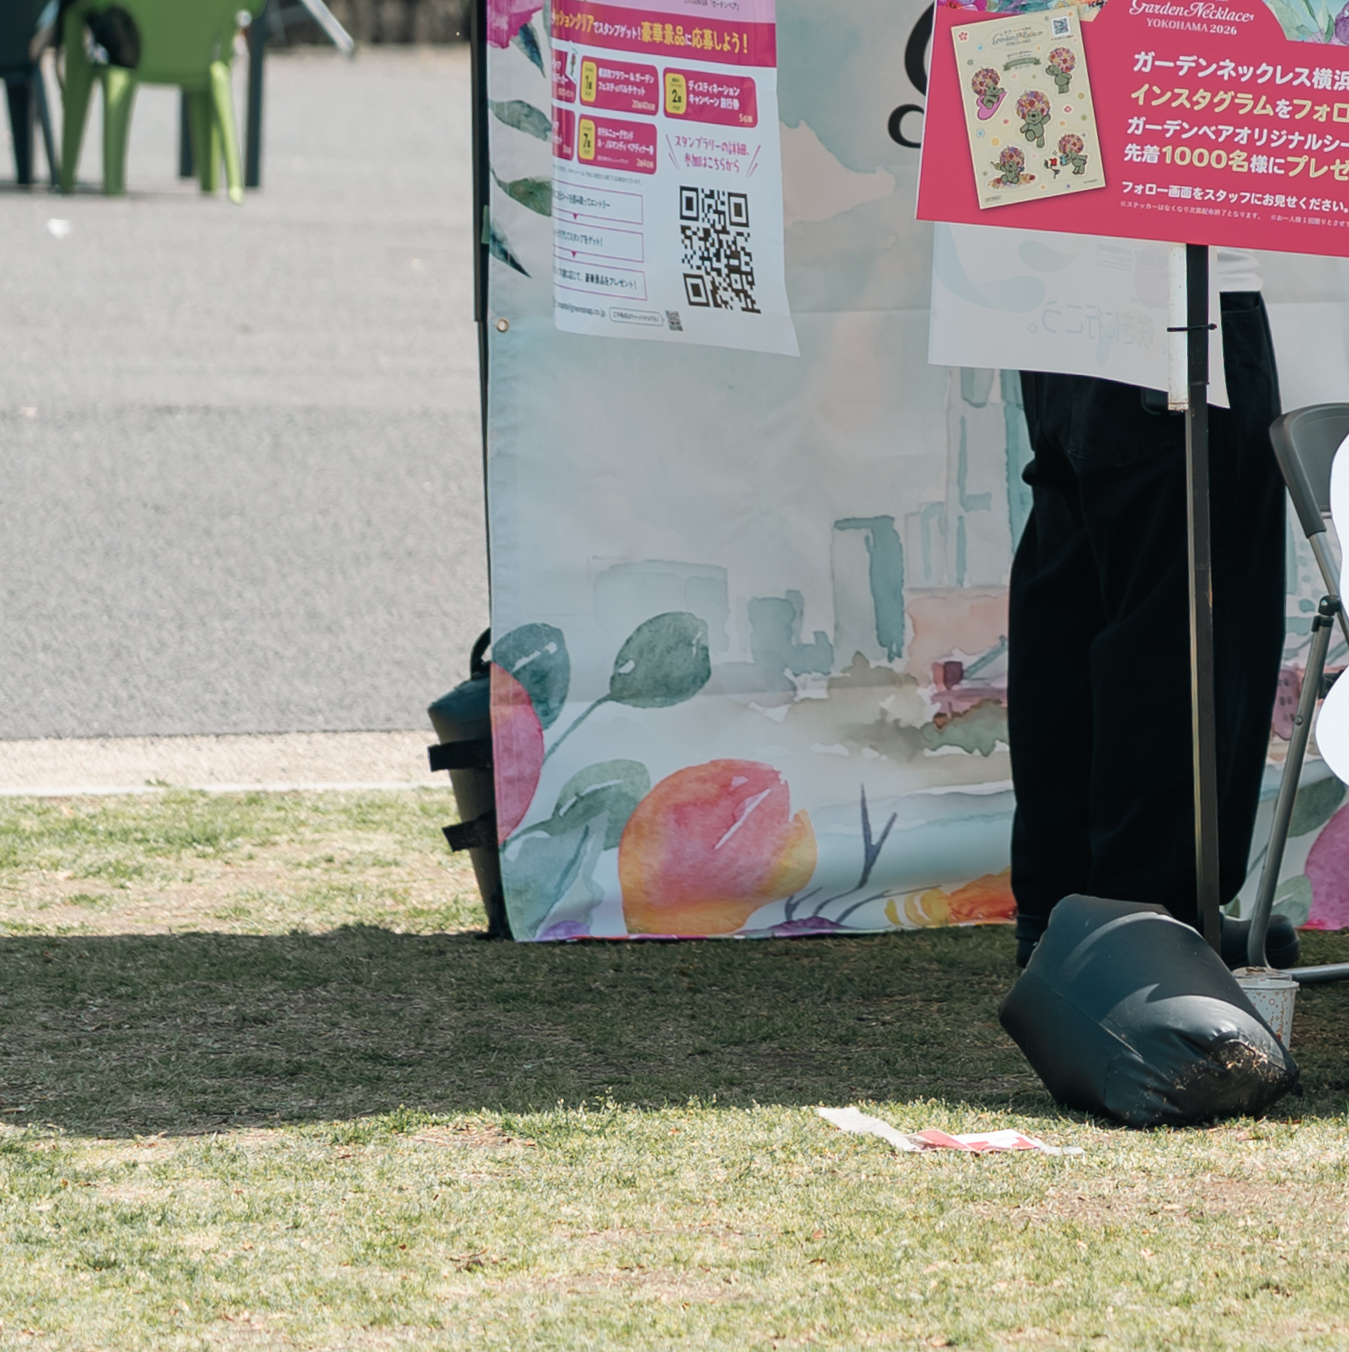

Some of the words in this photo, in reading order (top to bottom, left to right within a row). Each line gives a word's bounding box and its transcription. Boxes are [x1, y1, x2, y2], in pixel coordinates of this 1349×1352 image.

[1183, 1, 1249, 23] Necklace
[1146, 17, 1208, 33] YOKOHAMA
[1209, 23, 1238, 36] 2026
[1121, 180, 1349, 214] フォロー画面をスタッフにお見せください。
